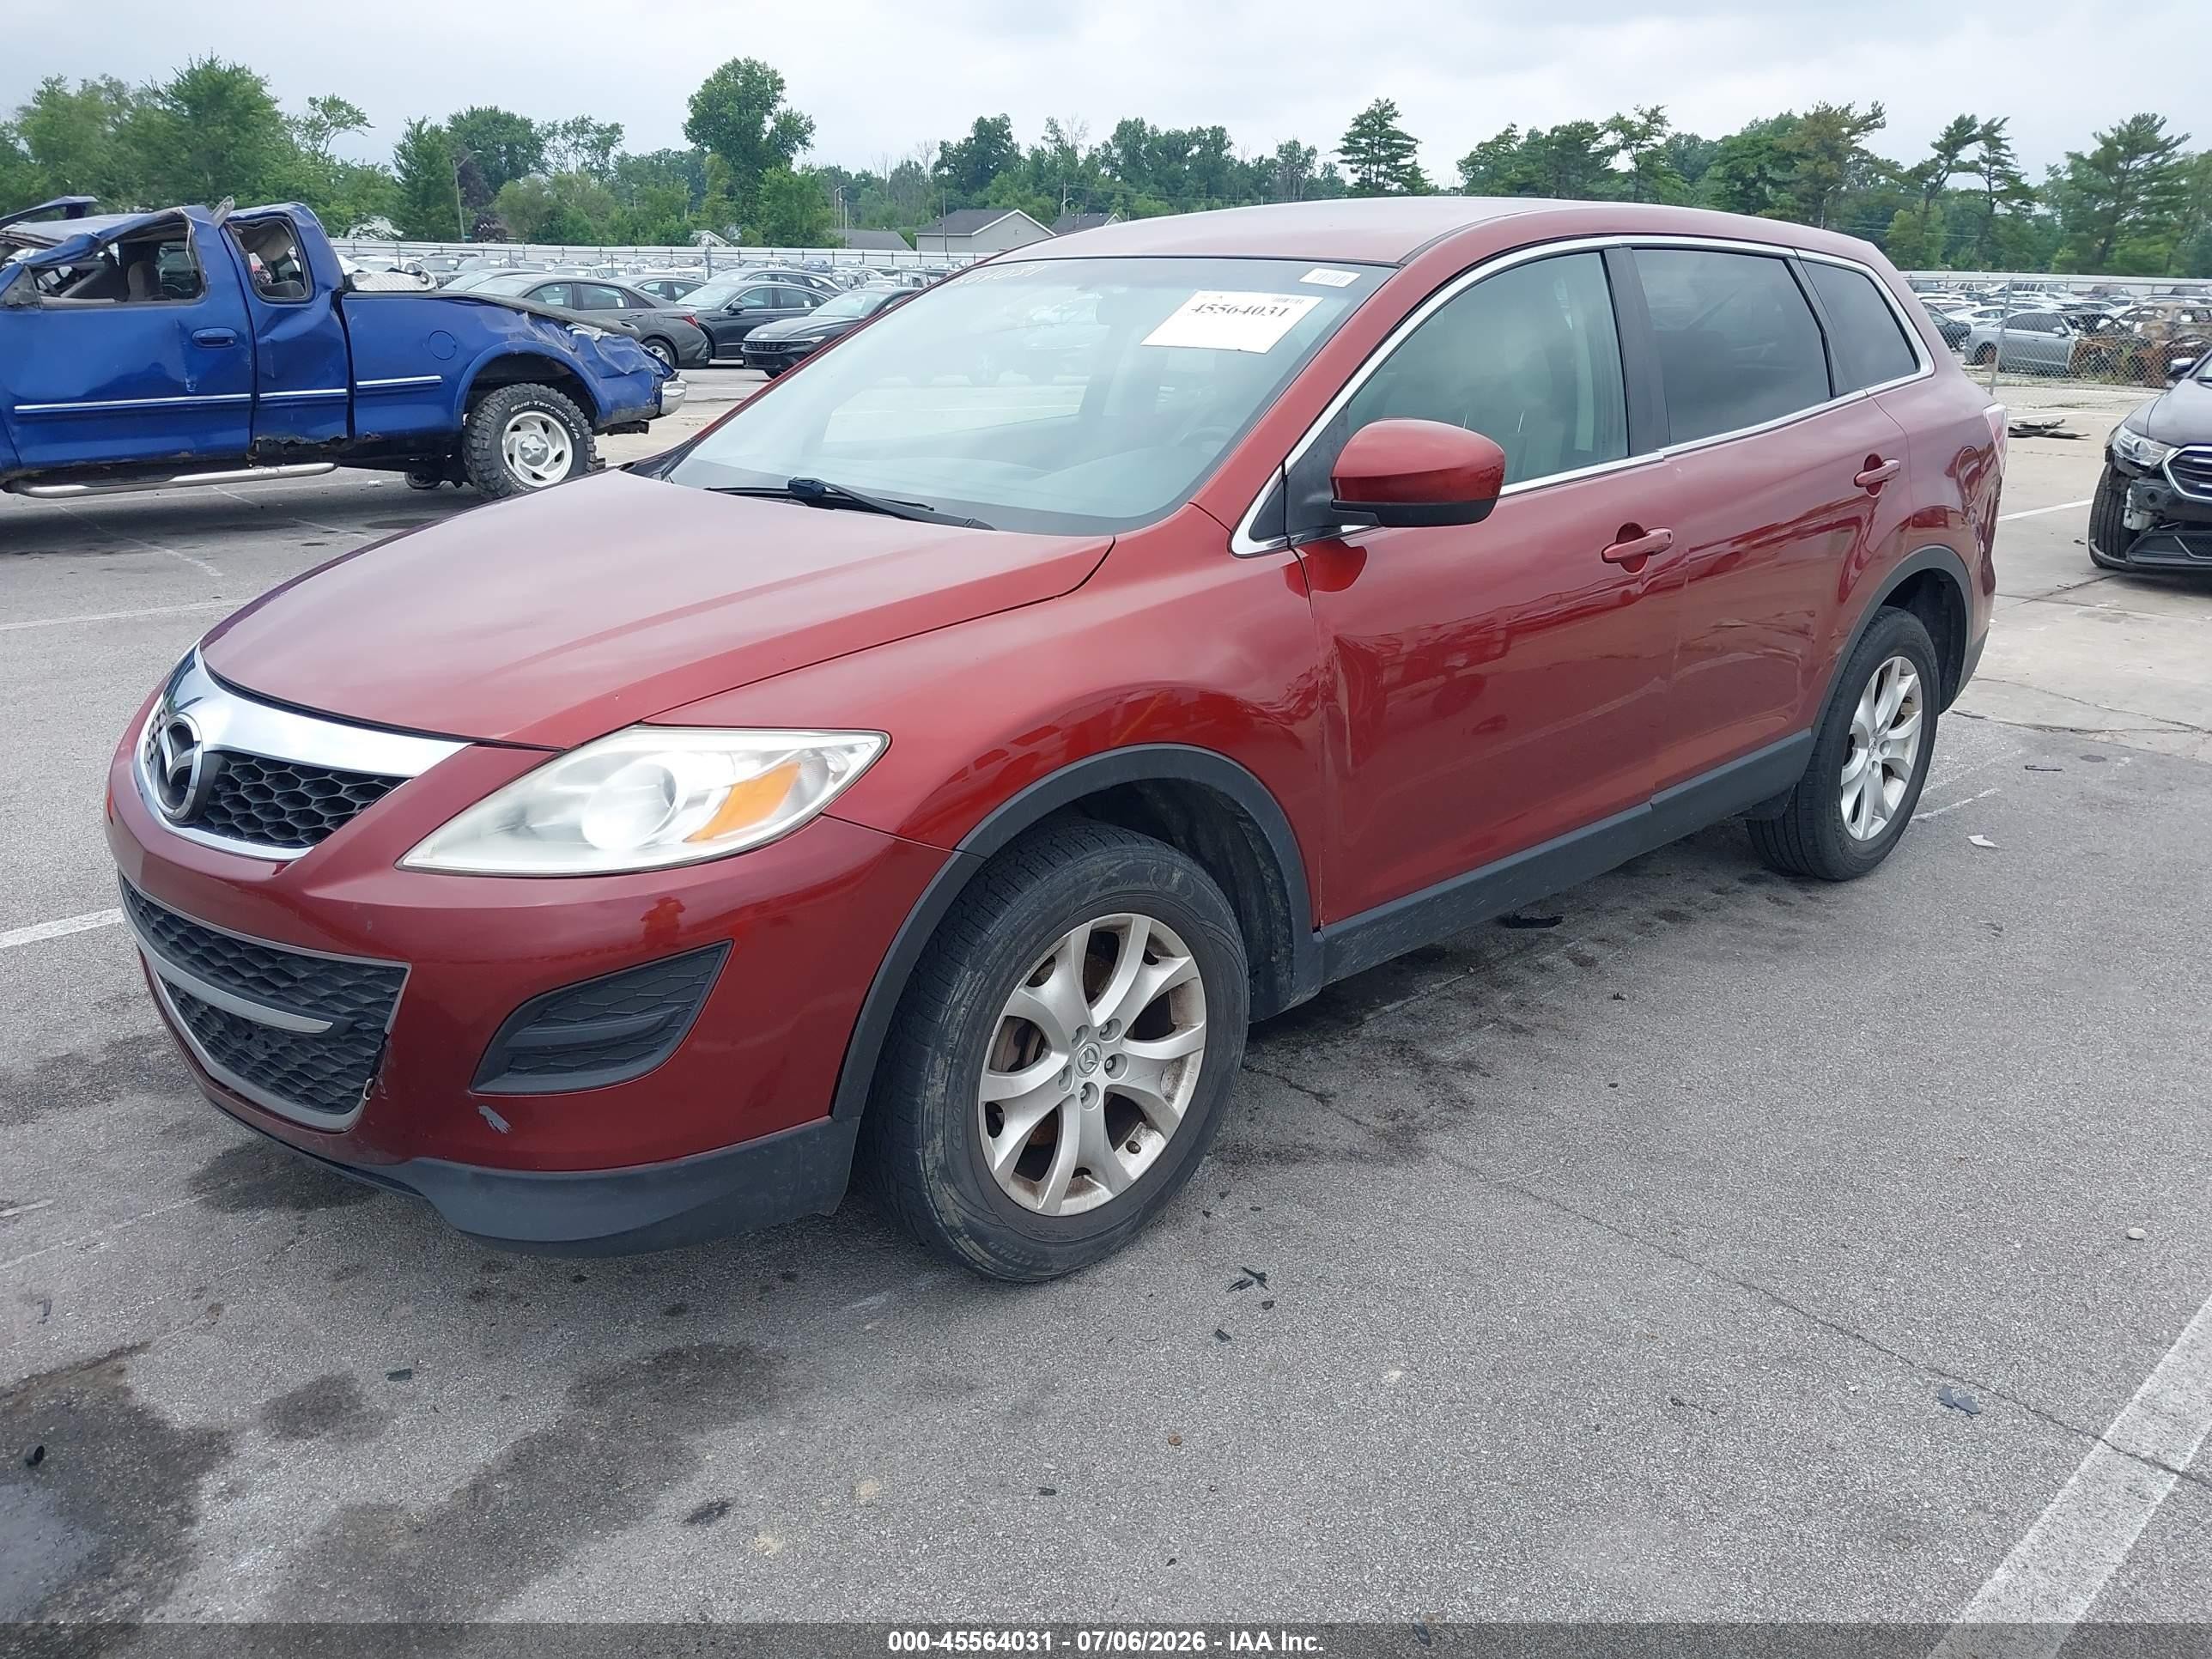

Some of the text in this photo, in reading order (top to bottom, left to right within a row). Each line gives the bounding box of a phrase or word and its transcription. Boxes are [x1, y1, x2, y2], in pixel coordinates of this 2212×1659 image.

[1191, 302, 1291, 317] 45564031
[510, 400, 580, 440] Mud-Terrain T/A
